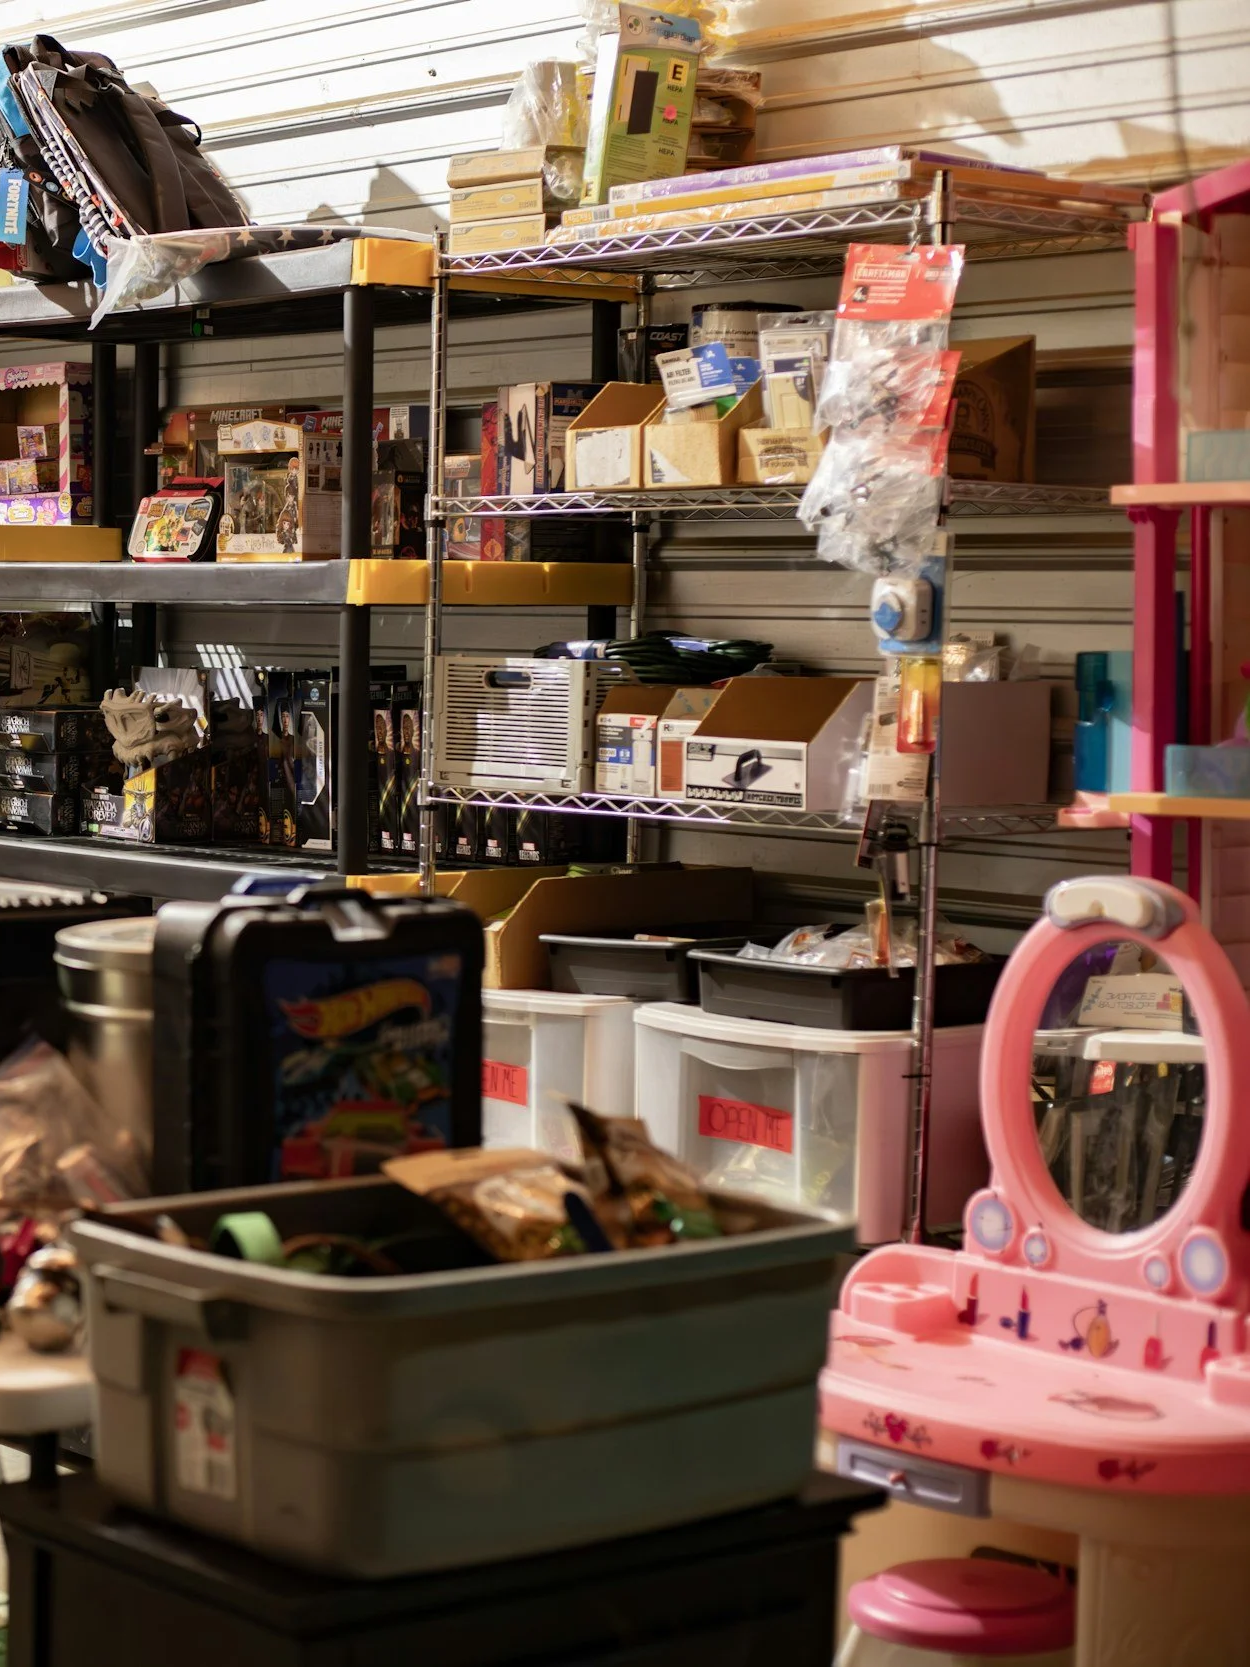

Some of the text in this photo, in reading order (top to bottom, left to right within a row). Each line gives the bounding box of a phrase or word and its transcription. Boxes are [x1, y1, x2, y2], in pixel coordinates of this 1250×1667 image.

[671, 64, 684, 81] E
[3, 178, 23, 235] FORTNITE
[650, 331, 685, 342] COAST
[209, 408, 264, 422] MINECRAFT
[83, 799, 117, 813] WAKANDA
[83, 810, 117, 822] FOREVER
[518, 849, 540, 861] LEGENDS
[503, 1069, 519, 1098] ME
[707, 1103, 784, 1148] OPEN ME
